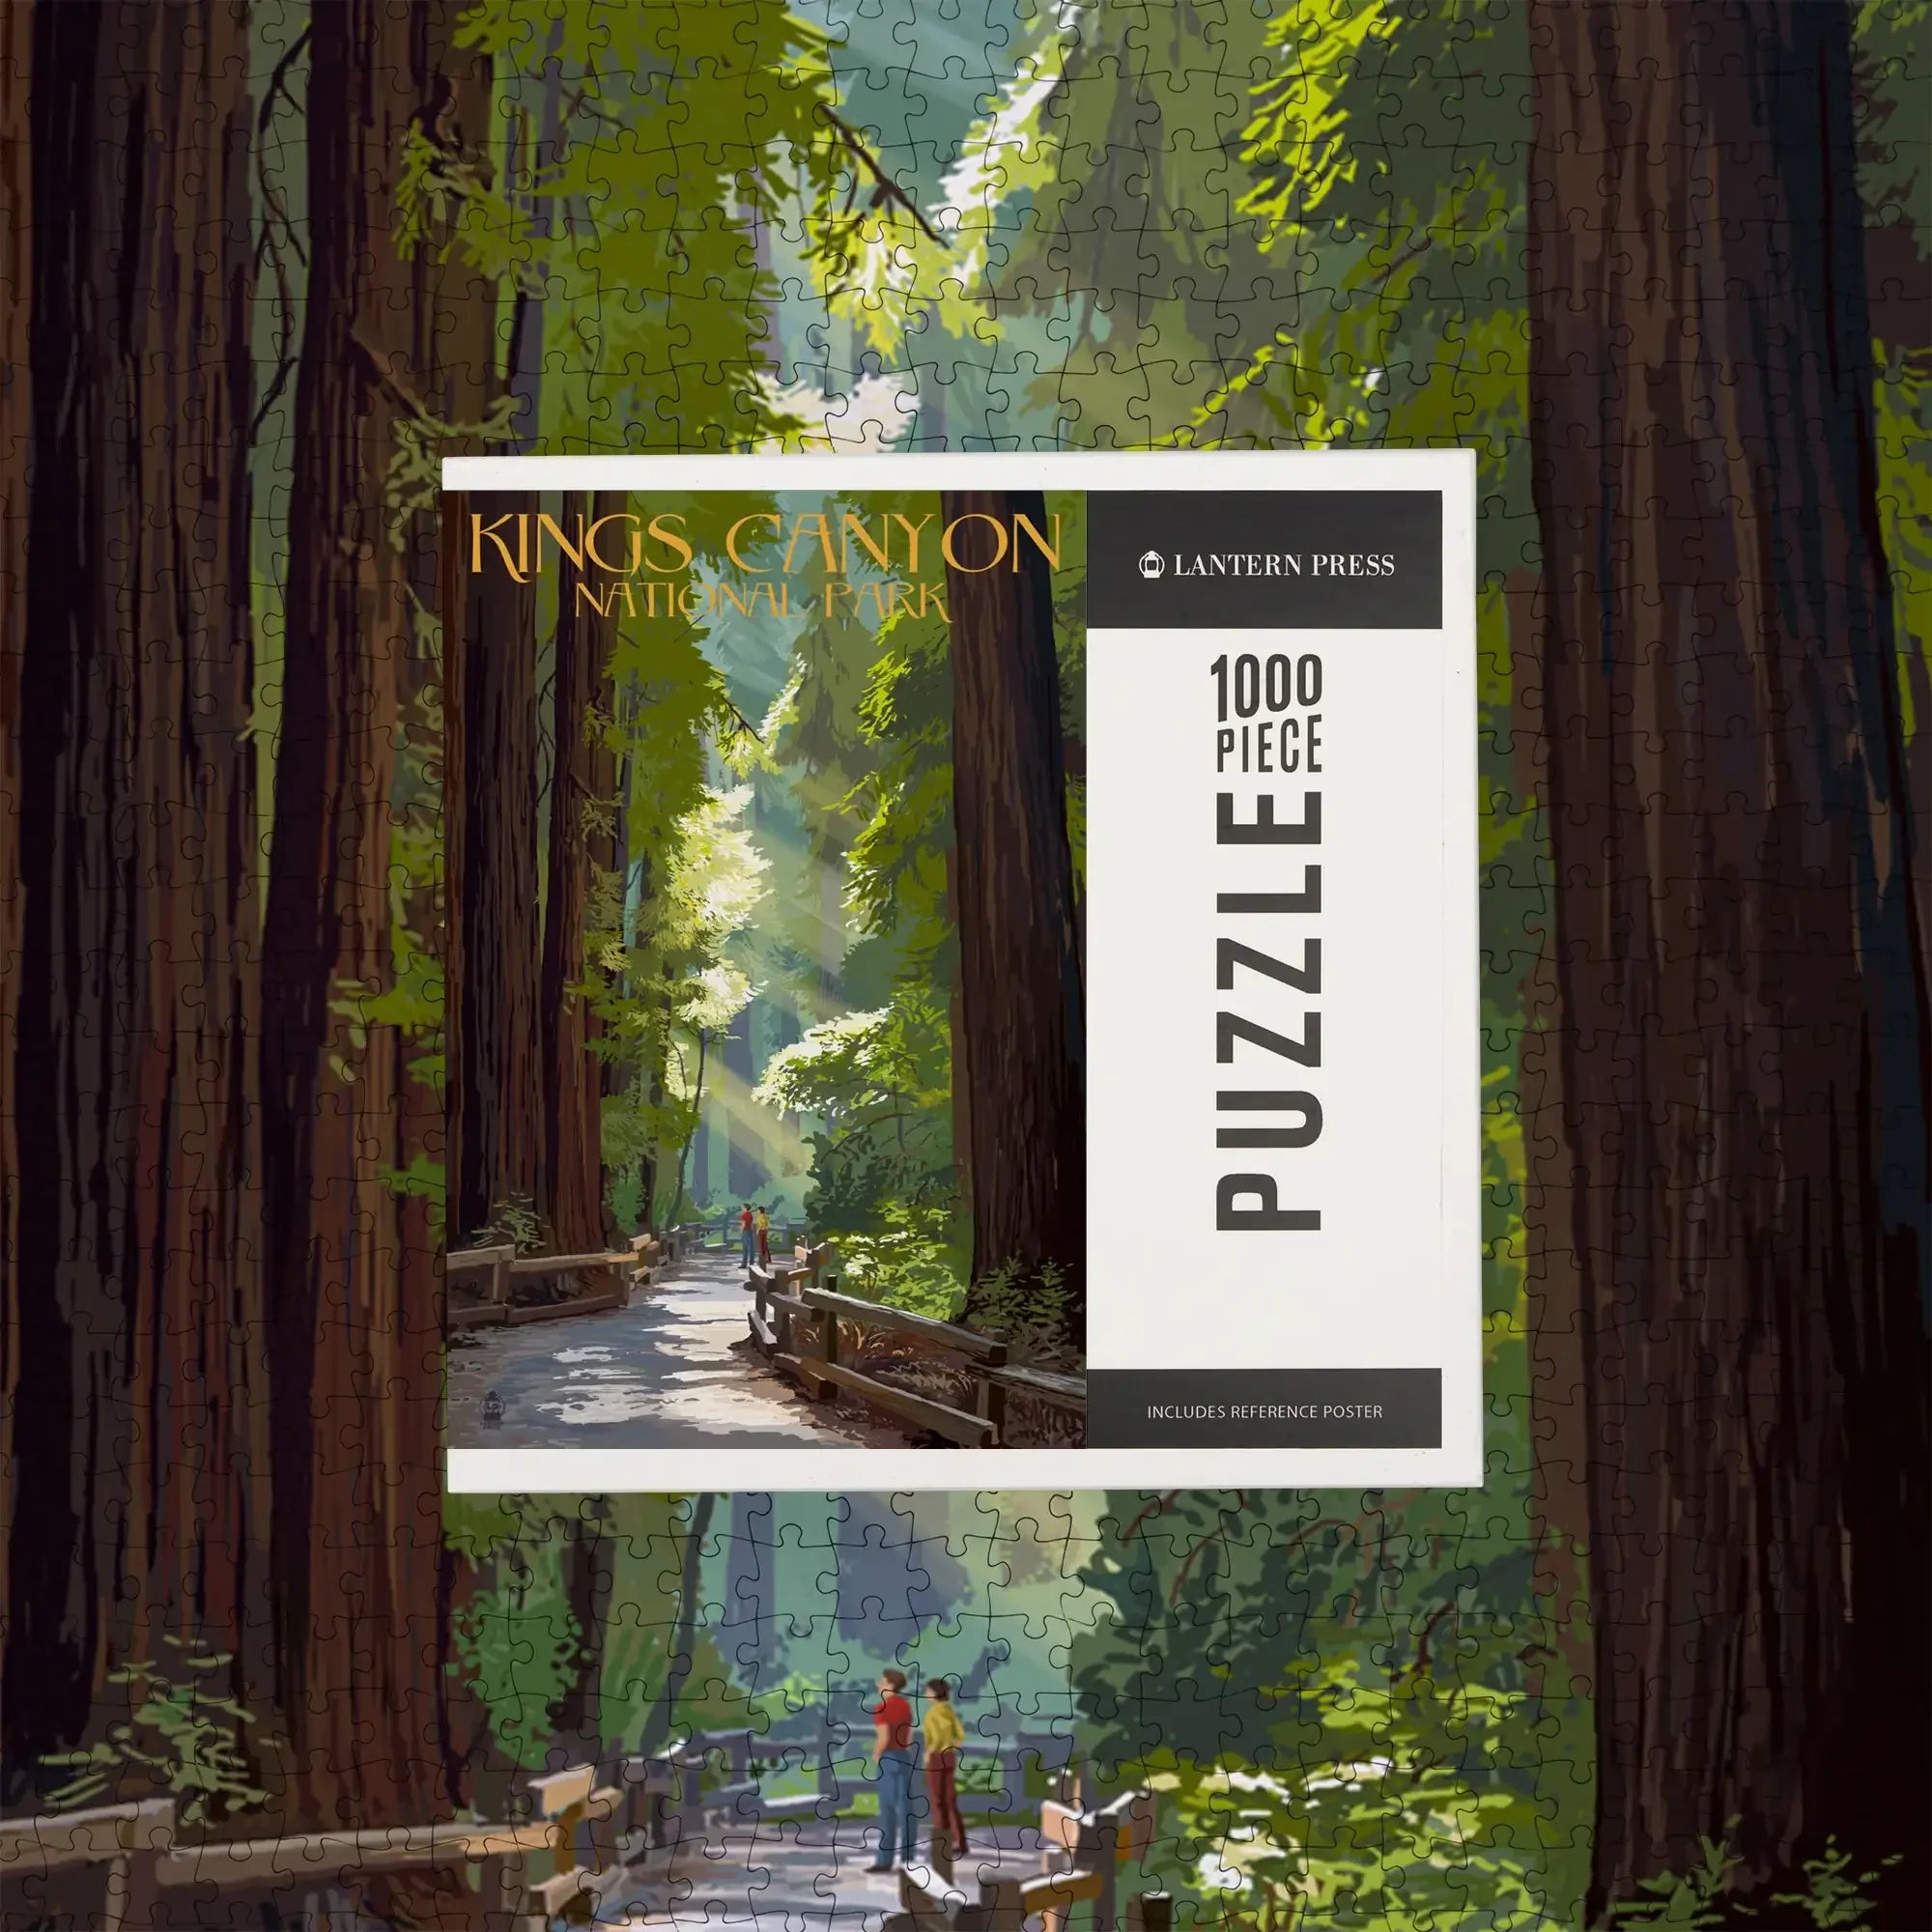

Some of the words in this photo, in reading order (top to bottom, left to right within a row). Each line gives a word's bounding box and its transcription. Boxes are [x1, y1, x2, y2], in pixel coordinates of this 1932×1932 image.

[470, 513, 694, 582] KINGS
[725, 513, 1062, 573] CANYON
[1174, 554, 1301, 577] LANTERN
[1311, 554, 1396, 577] PRESS
[575, 582, 804, 618] NATIONAL
[824, 582, 953, 623] PARK
[1210, 653, 1322, 723] 1000
[1216, 714, 1322, 773] PIECE
[1216, 791, 1323, 1232] PUZZLE
[1147, 1405, 1226, 1419] INCLUDES
[1231, 1405, 1319, 1419] REFERENCE
[1322, 1405, 1383, 1419] POSTER
